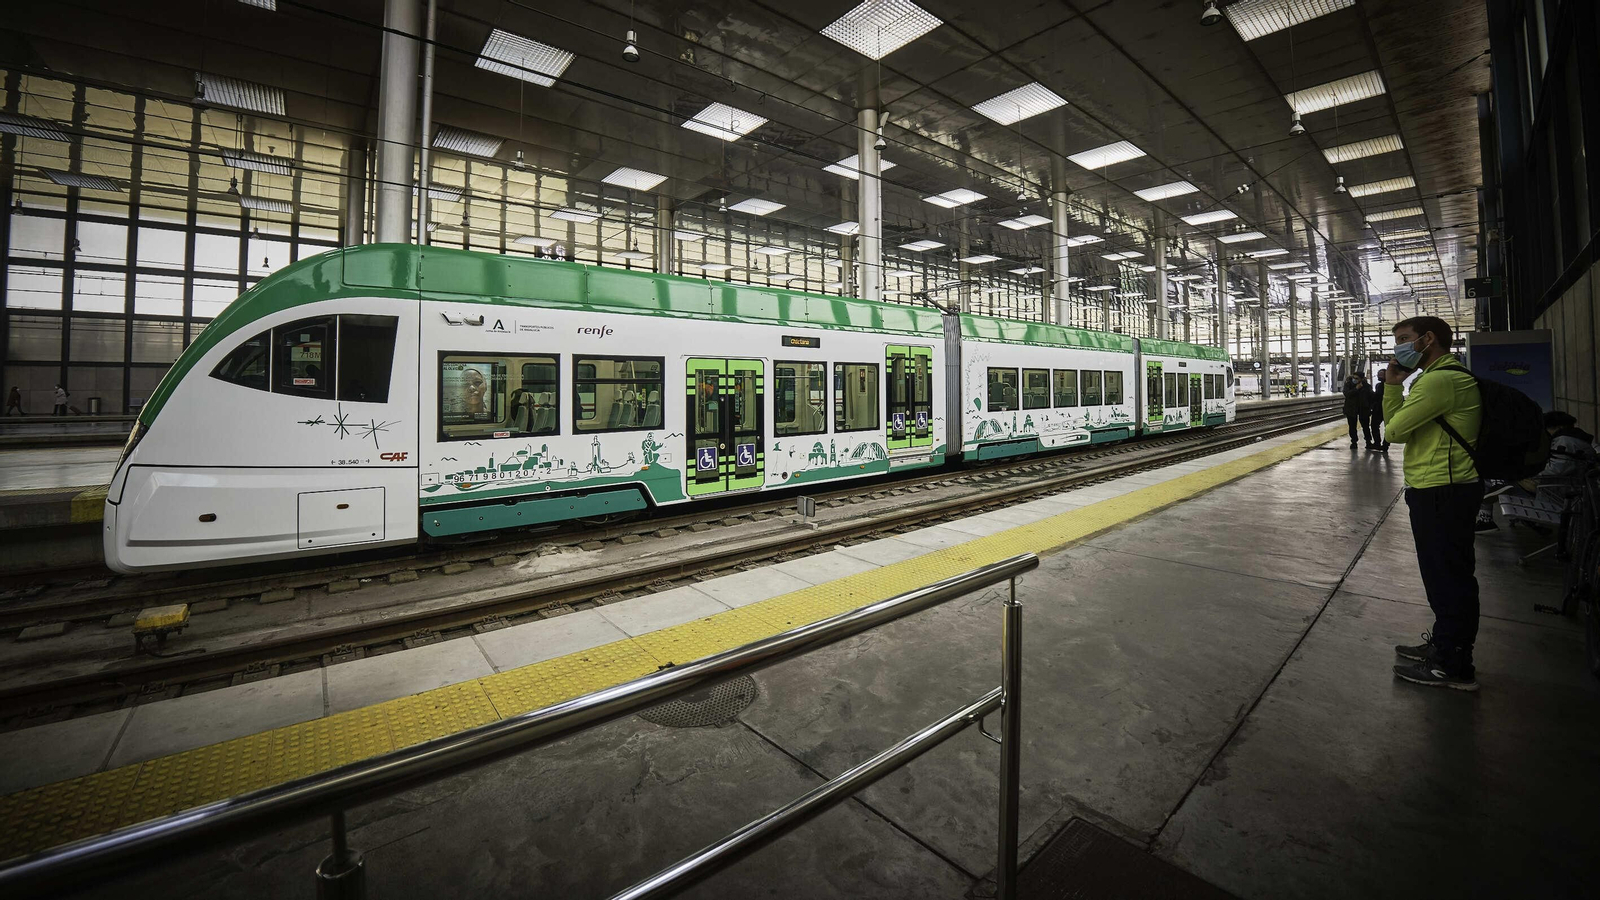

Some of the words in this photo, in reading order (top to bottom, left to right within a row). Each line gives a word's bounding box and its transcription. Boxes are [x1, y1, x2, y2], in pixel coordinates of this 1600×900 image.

[1467, 287, 1476, 298] 6
[577, 324, 614, 339] renfe
[380, 452, 408, 462] CAF
